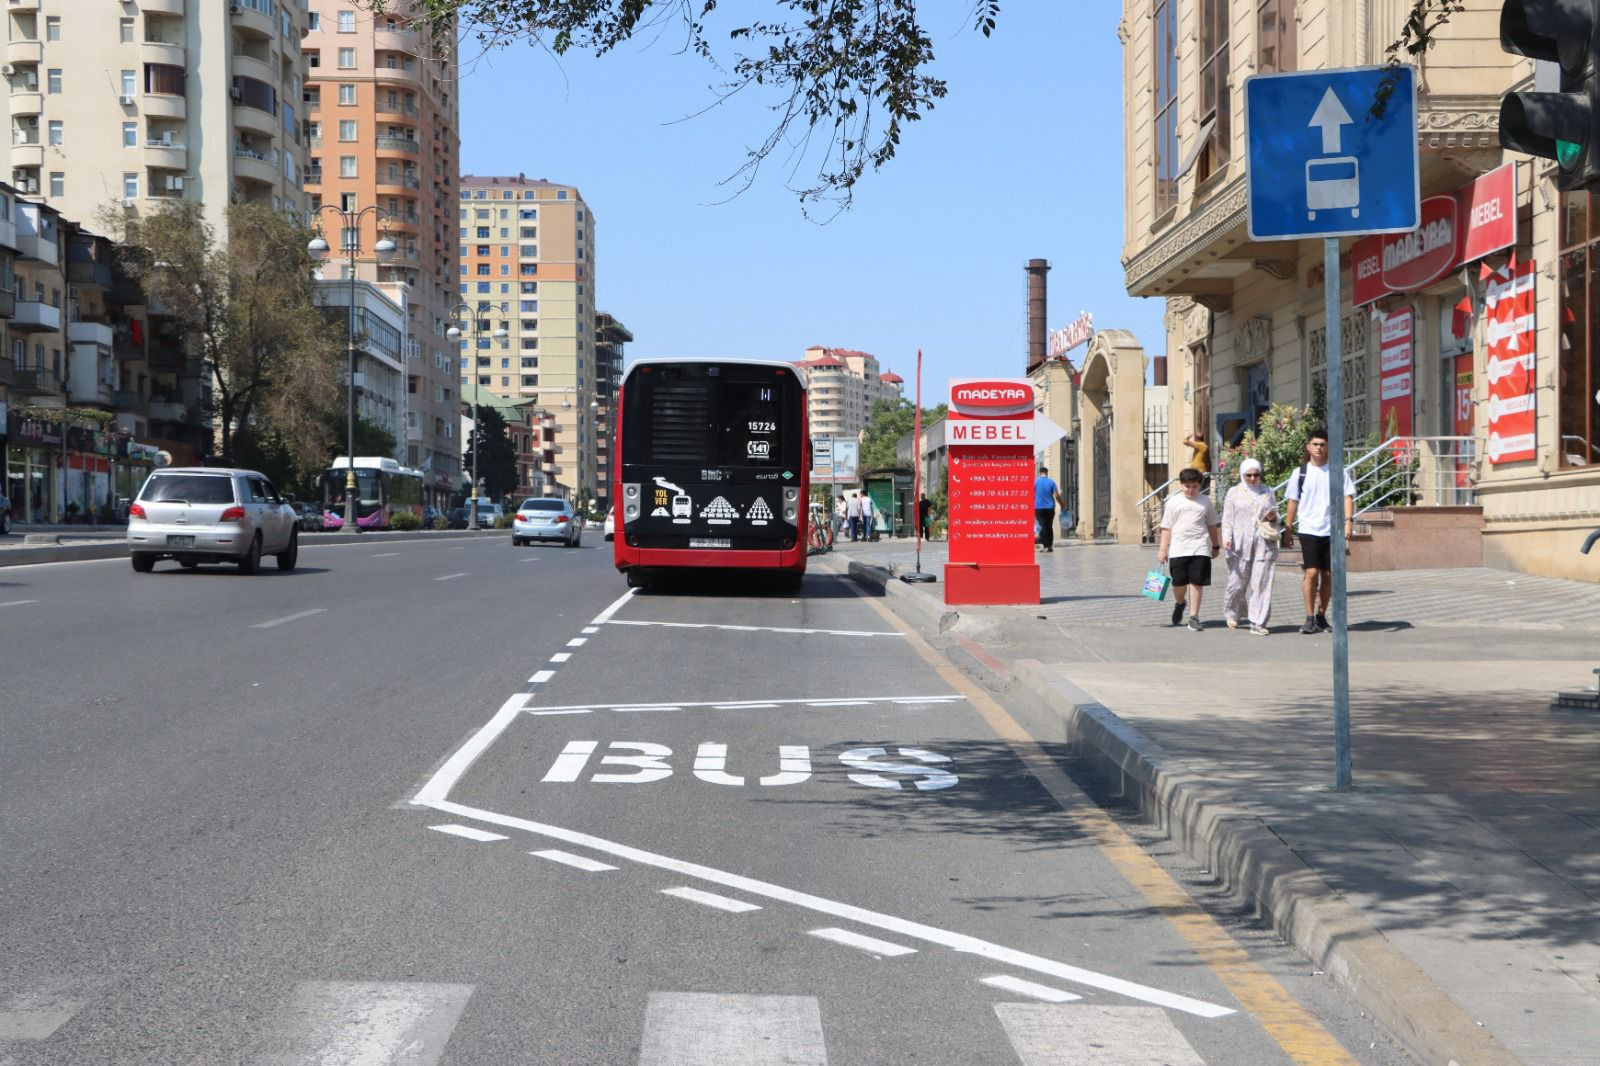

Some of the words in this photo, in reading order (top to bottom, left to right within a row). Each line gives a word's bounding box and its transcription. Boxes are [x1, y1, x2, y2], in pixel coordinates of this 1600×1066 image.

[1471, 198, 1503, 229] MEBEL
[1357, 255, 1381, 280] MEBEL
[1384, 217, 1453, 272] MADEYRA
[957, 389, 1026, 400] MADEYRA
[748, 422, 776, 431] 15726
[953, 426, 1026, 440] MEBEL
[752, 444, 767, 453] 141
[655, 489, 667, 498] YOL
[655, 497, 667, 505] VER
[540, 740, 960, 790] BUS
